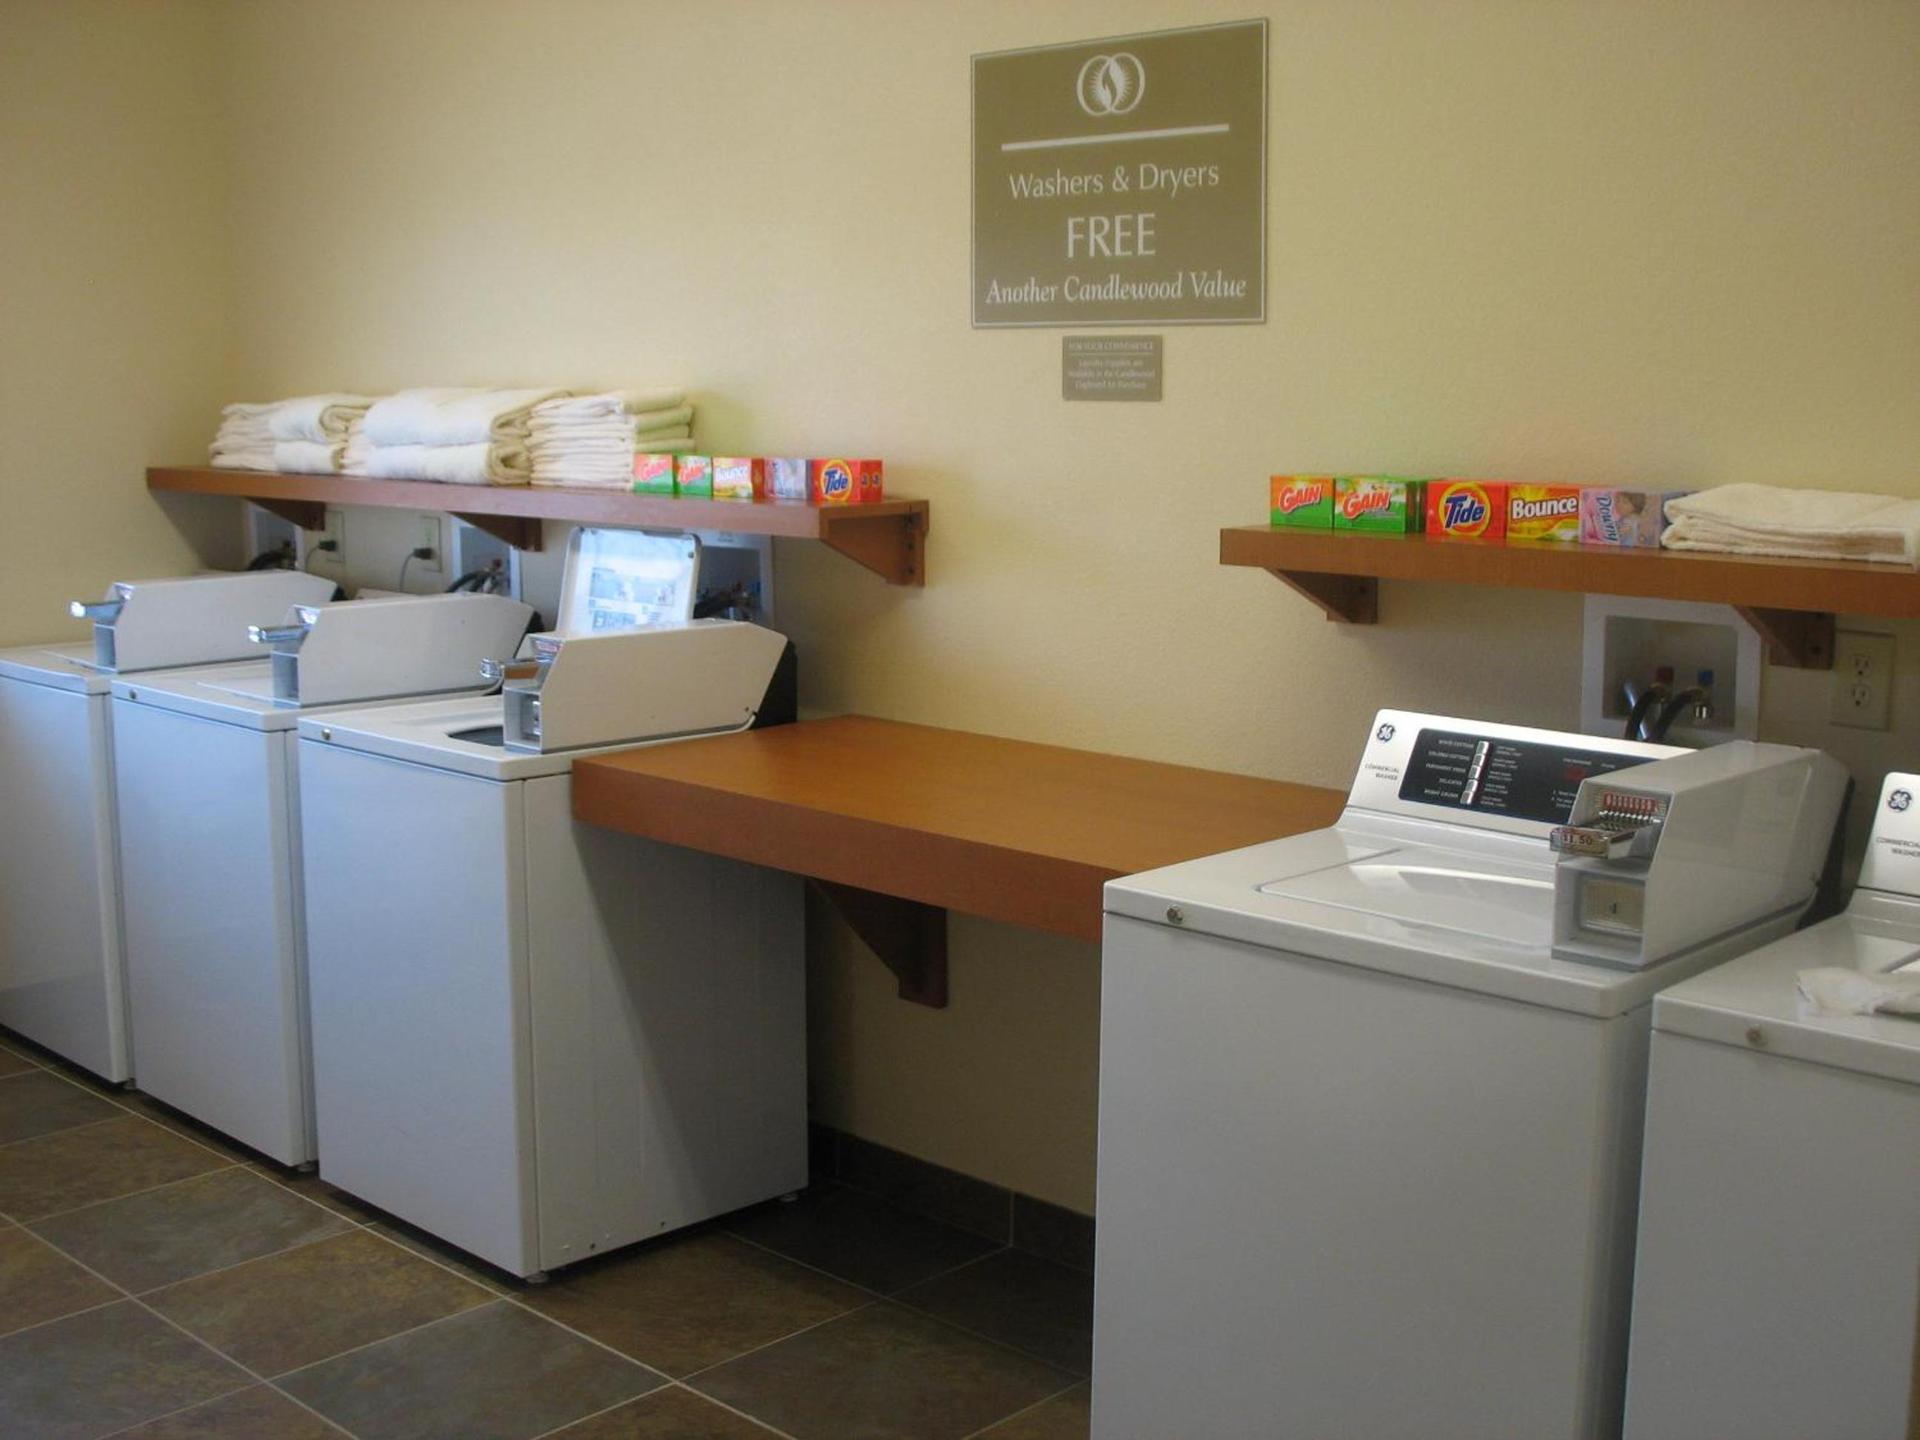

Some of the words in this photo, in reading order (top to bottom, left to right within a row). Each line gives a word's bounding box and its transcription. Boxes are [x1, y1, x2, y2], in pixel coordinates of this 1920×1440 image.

[1009, 168, 1104, 199] Washers
[1112, 165, 1129, 193] &
[1139, 163, 1219, 199] Dryers
[1066, 213, 1157, 259] FREE
[986, 277, 1059, 304] Another
[1063, 272, 1182, 302] Candlewood
[1190, 270, 1247, 298] Value
[823, 469, 849, 494] Tide
[1444, 492, 1485, 530] Tide
[1512, 496, 1578, 520] Bounce
[1594, 492, 1618, 542] Downy
